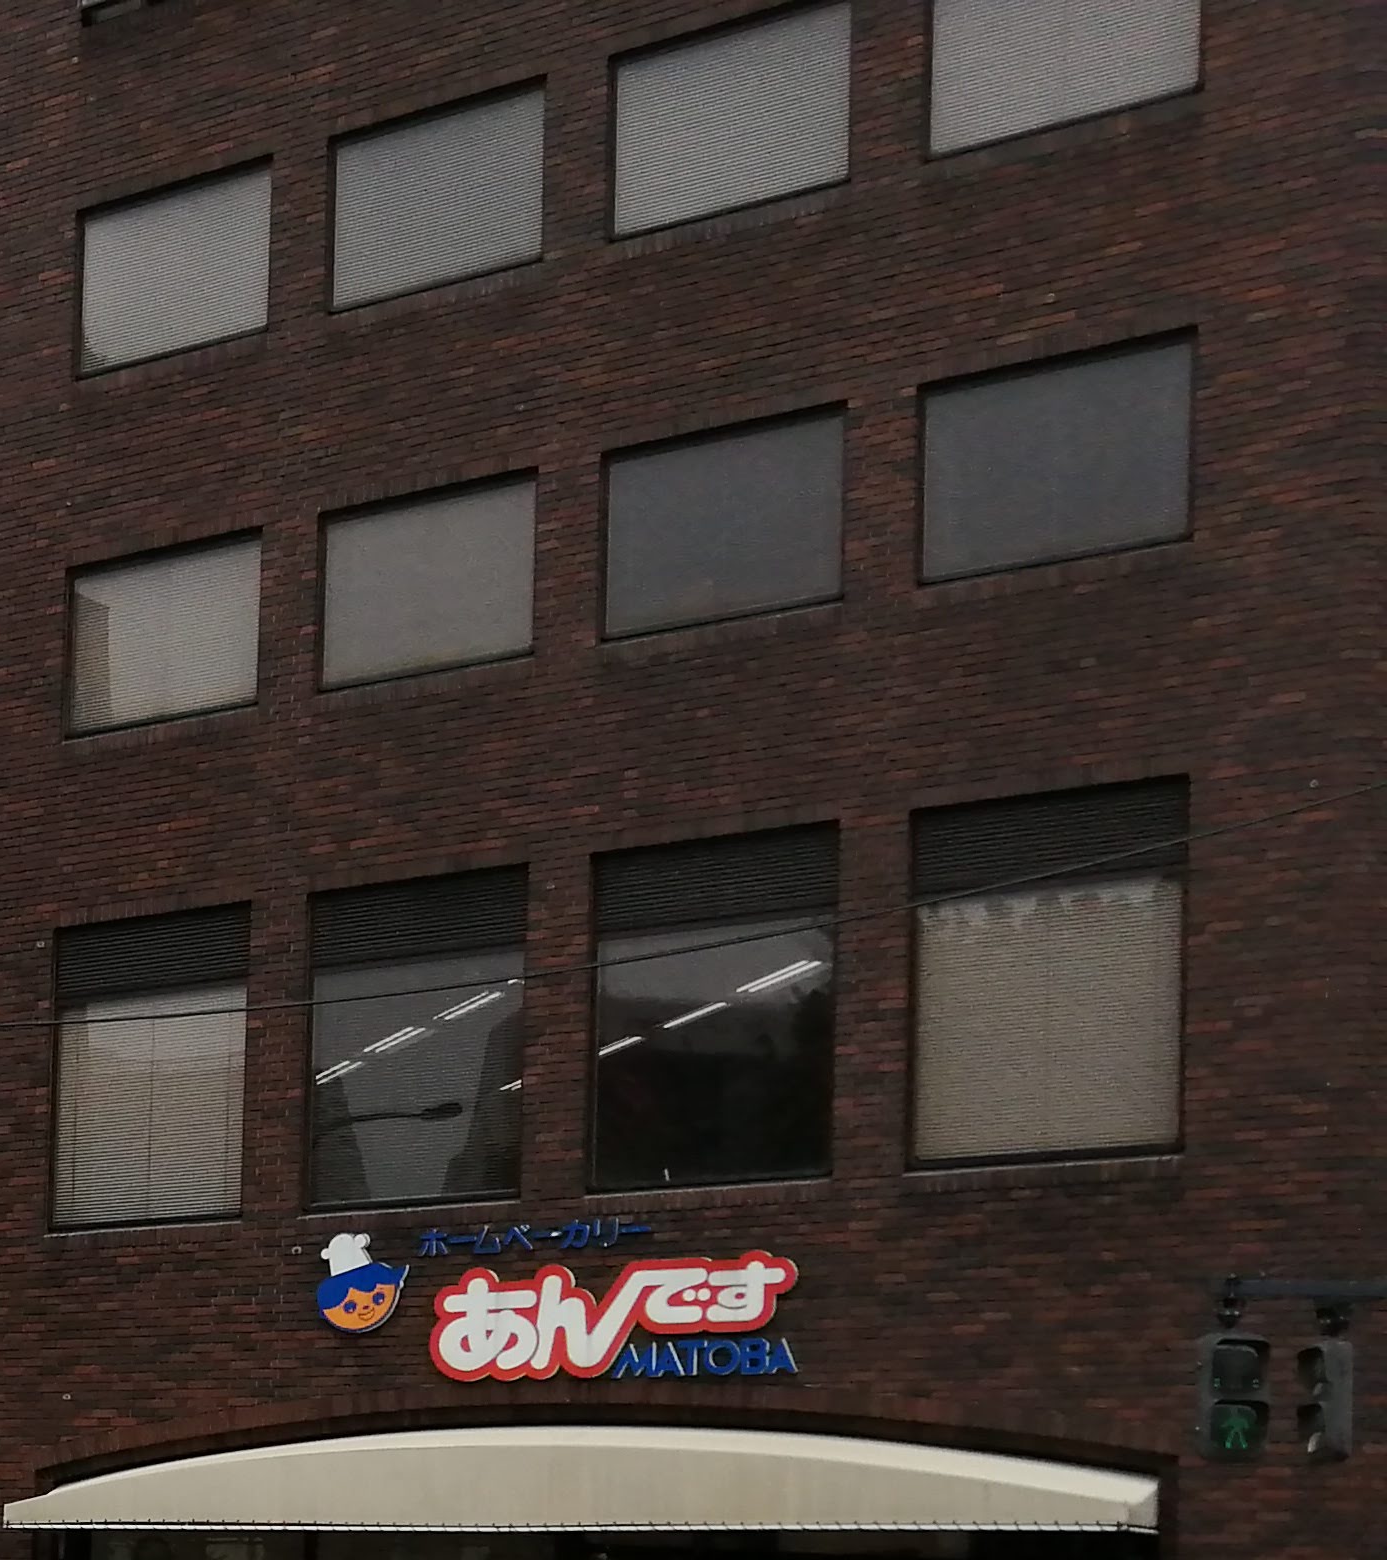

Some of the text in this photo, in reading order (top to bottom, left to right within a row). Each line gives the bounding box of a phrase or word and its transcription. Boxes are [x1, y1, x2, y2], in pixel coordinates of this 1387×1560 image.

[417, 1220, 652, 1257] ホームベーカリー
[611, 1337, 799, 1379] MATOBA
